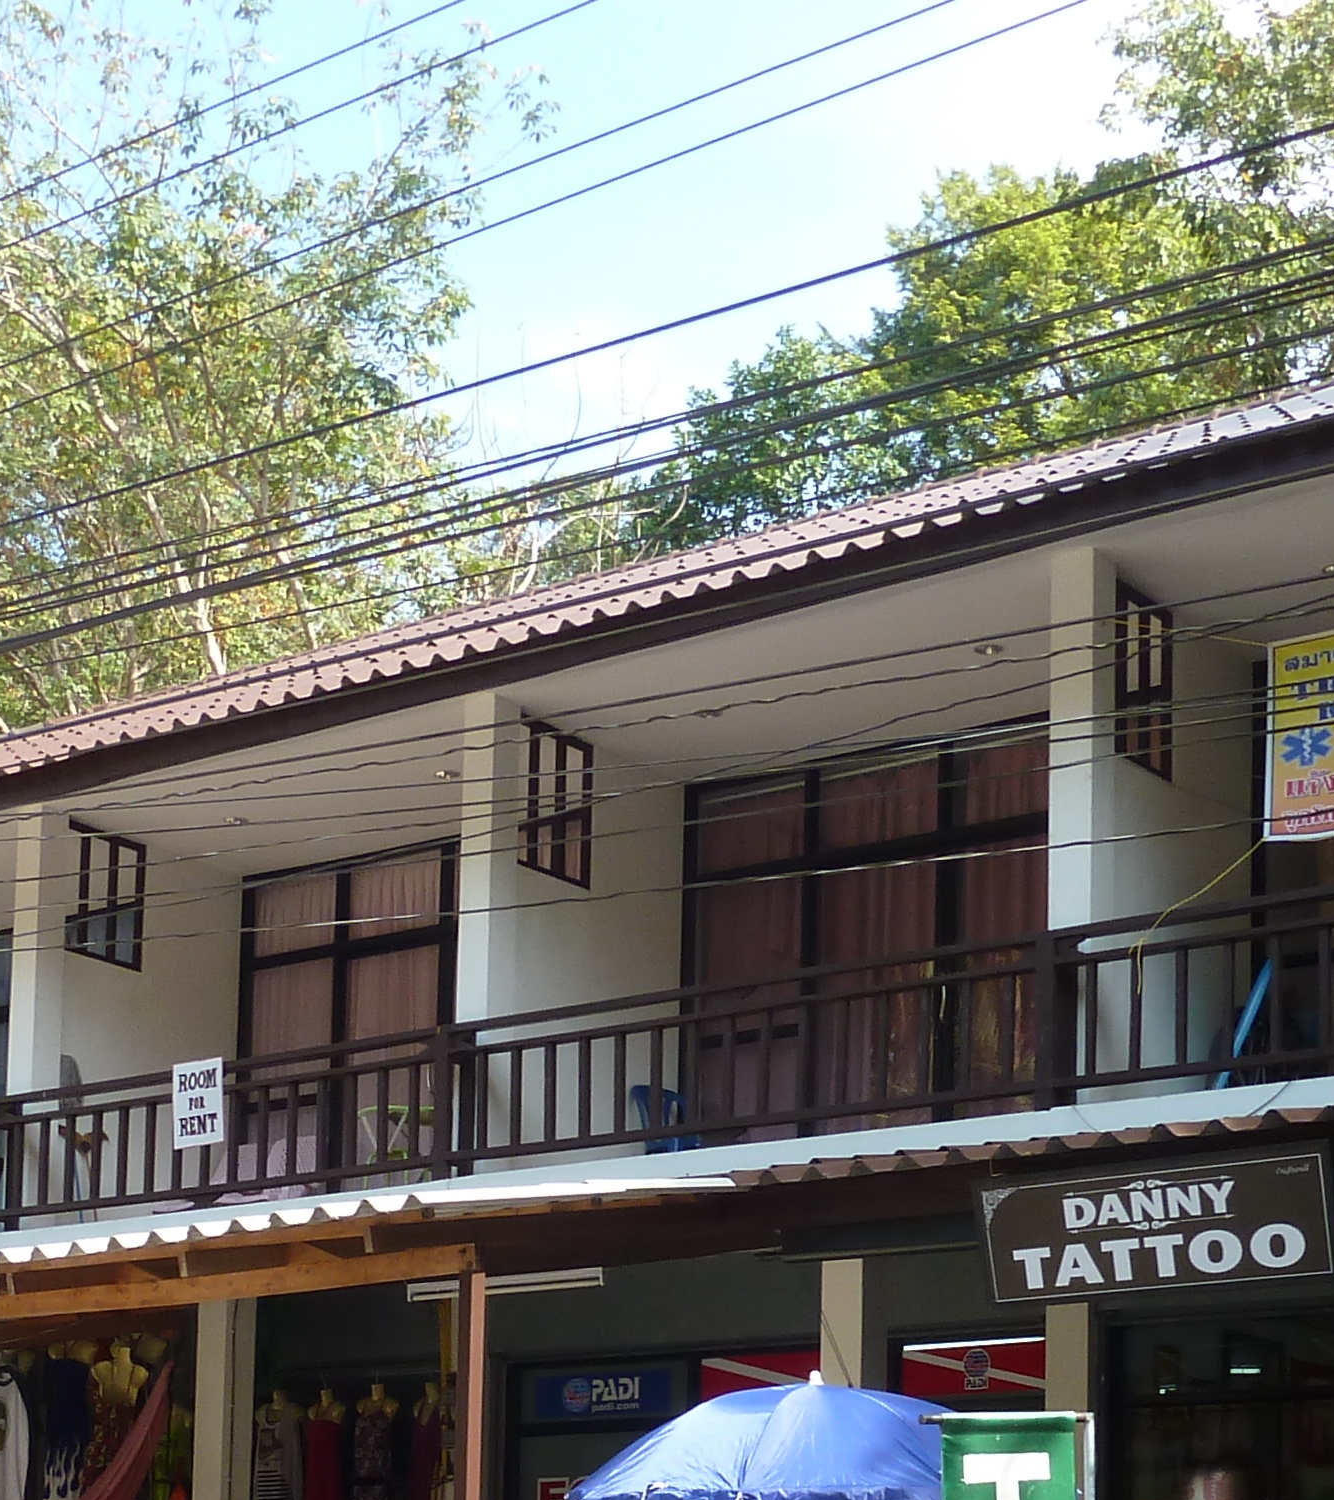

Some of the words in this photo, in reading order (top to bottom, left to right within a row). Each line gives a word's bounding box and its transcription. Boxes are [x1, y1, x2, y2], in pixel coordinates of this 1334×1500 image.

[178, 1067, 217, 1093] ROOM
[188, 1096, 206, 1110] FOR
[178, 1112, 218, 1137] RENT
[1062, 1180, 1235, 1230] DANNY
[1013, 1223, 1306, 1290] TATTOO
[592, 1376, 641, 1401] PADI
[592, 1402, 639, 1413] padi.com
